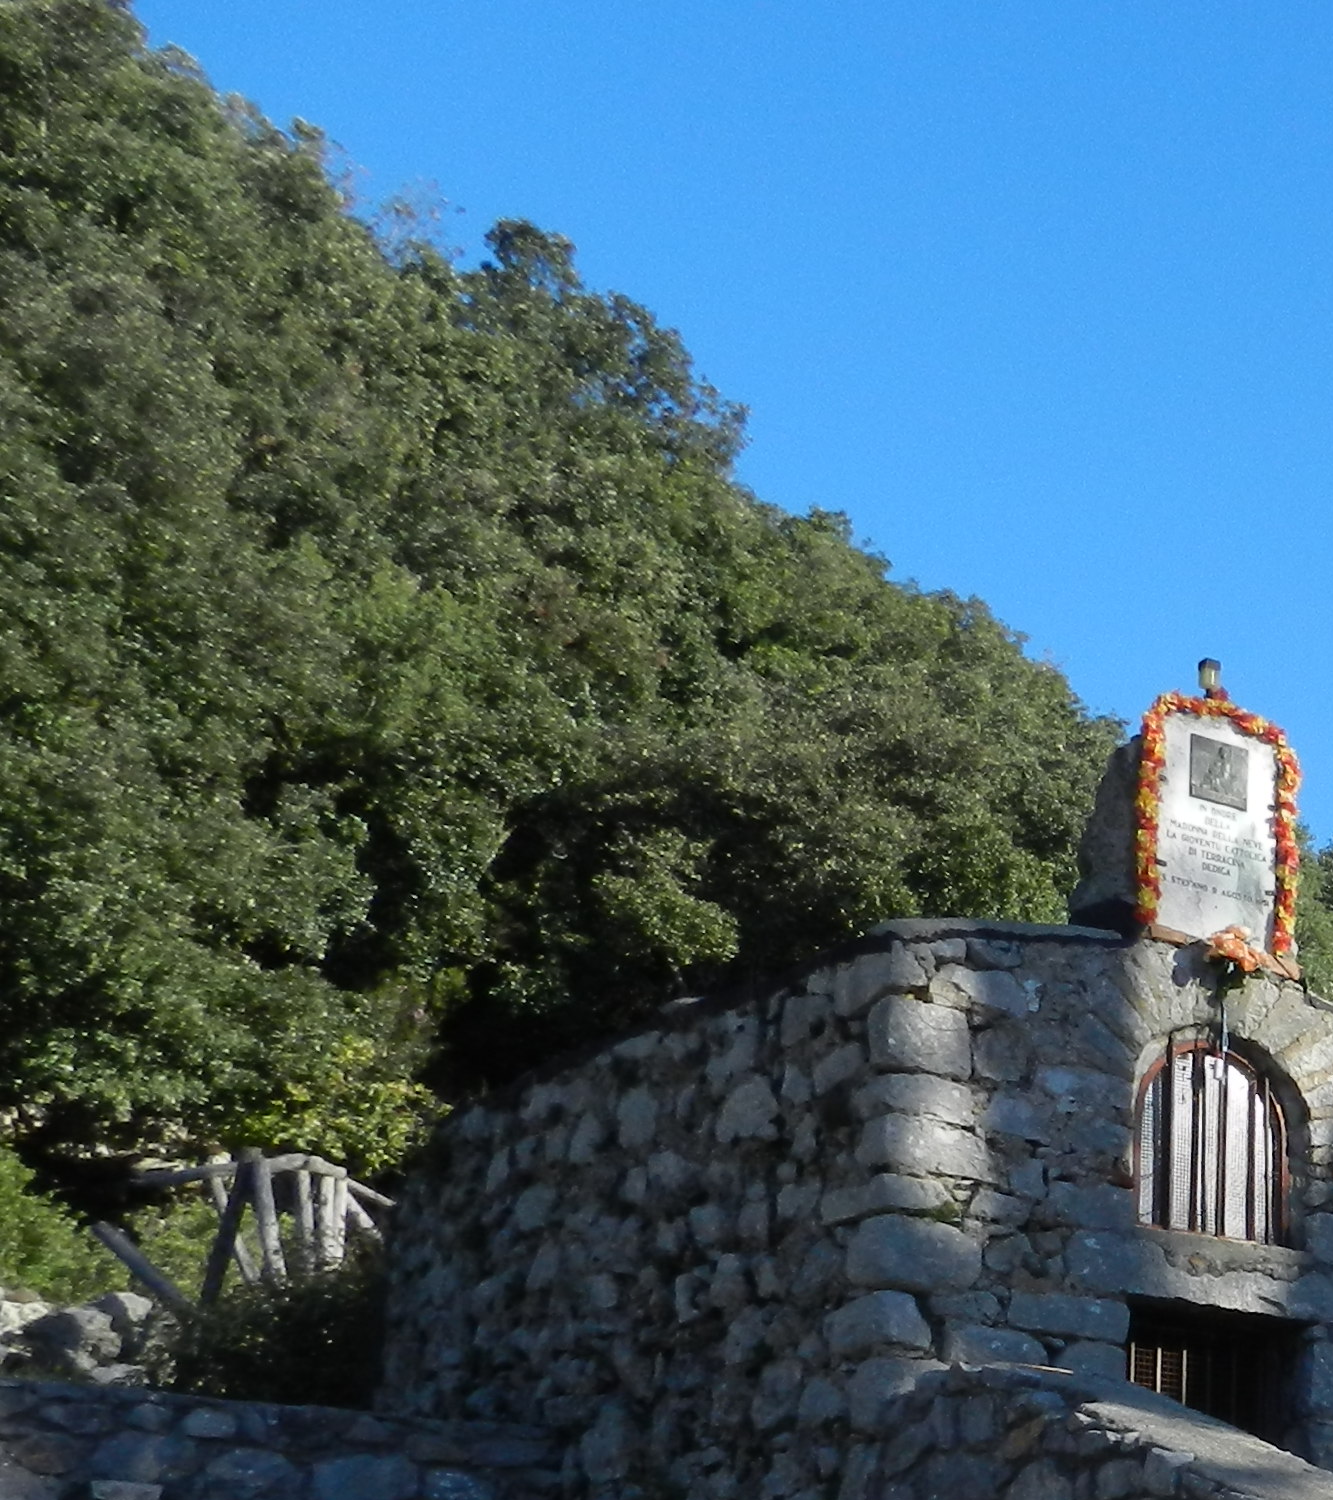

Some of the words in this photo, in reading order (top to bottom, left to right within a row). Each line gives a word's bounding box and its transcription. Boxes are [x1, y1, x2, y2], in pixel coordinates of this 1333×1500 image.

[1204, 816, 1231, 830] DELLA
[1170, 818, 1208, 835] MADONNA
[1212, 829, 1239, 844] DELLA
[1242, 838, 1262, 851] NEVE
[1166, 829, 1177, 839] LA
[1224, 845, 1267, 862] CATTOLICA
[1201, 861, 1231, 876] DEDICA
[1171, 875, 1209, 892] STEFANO
